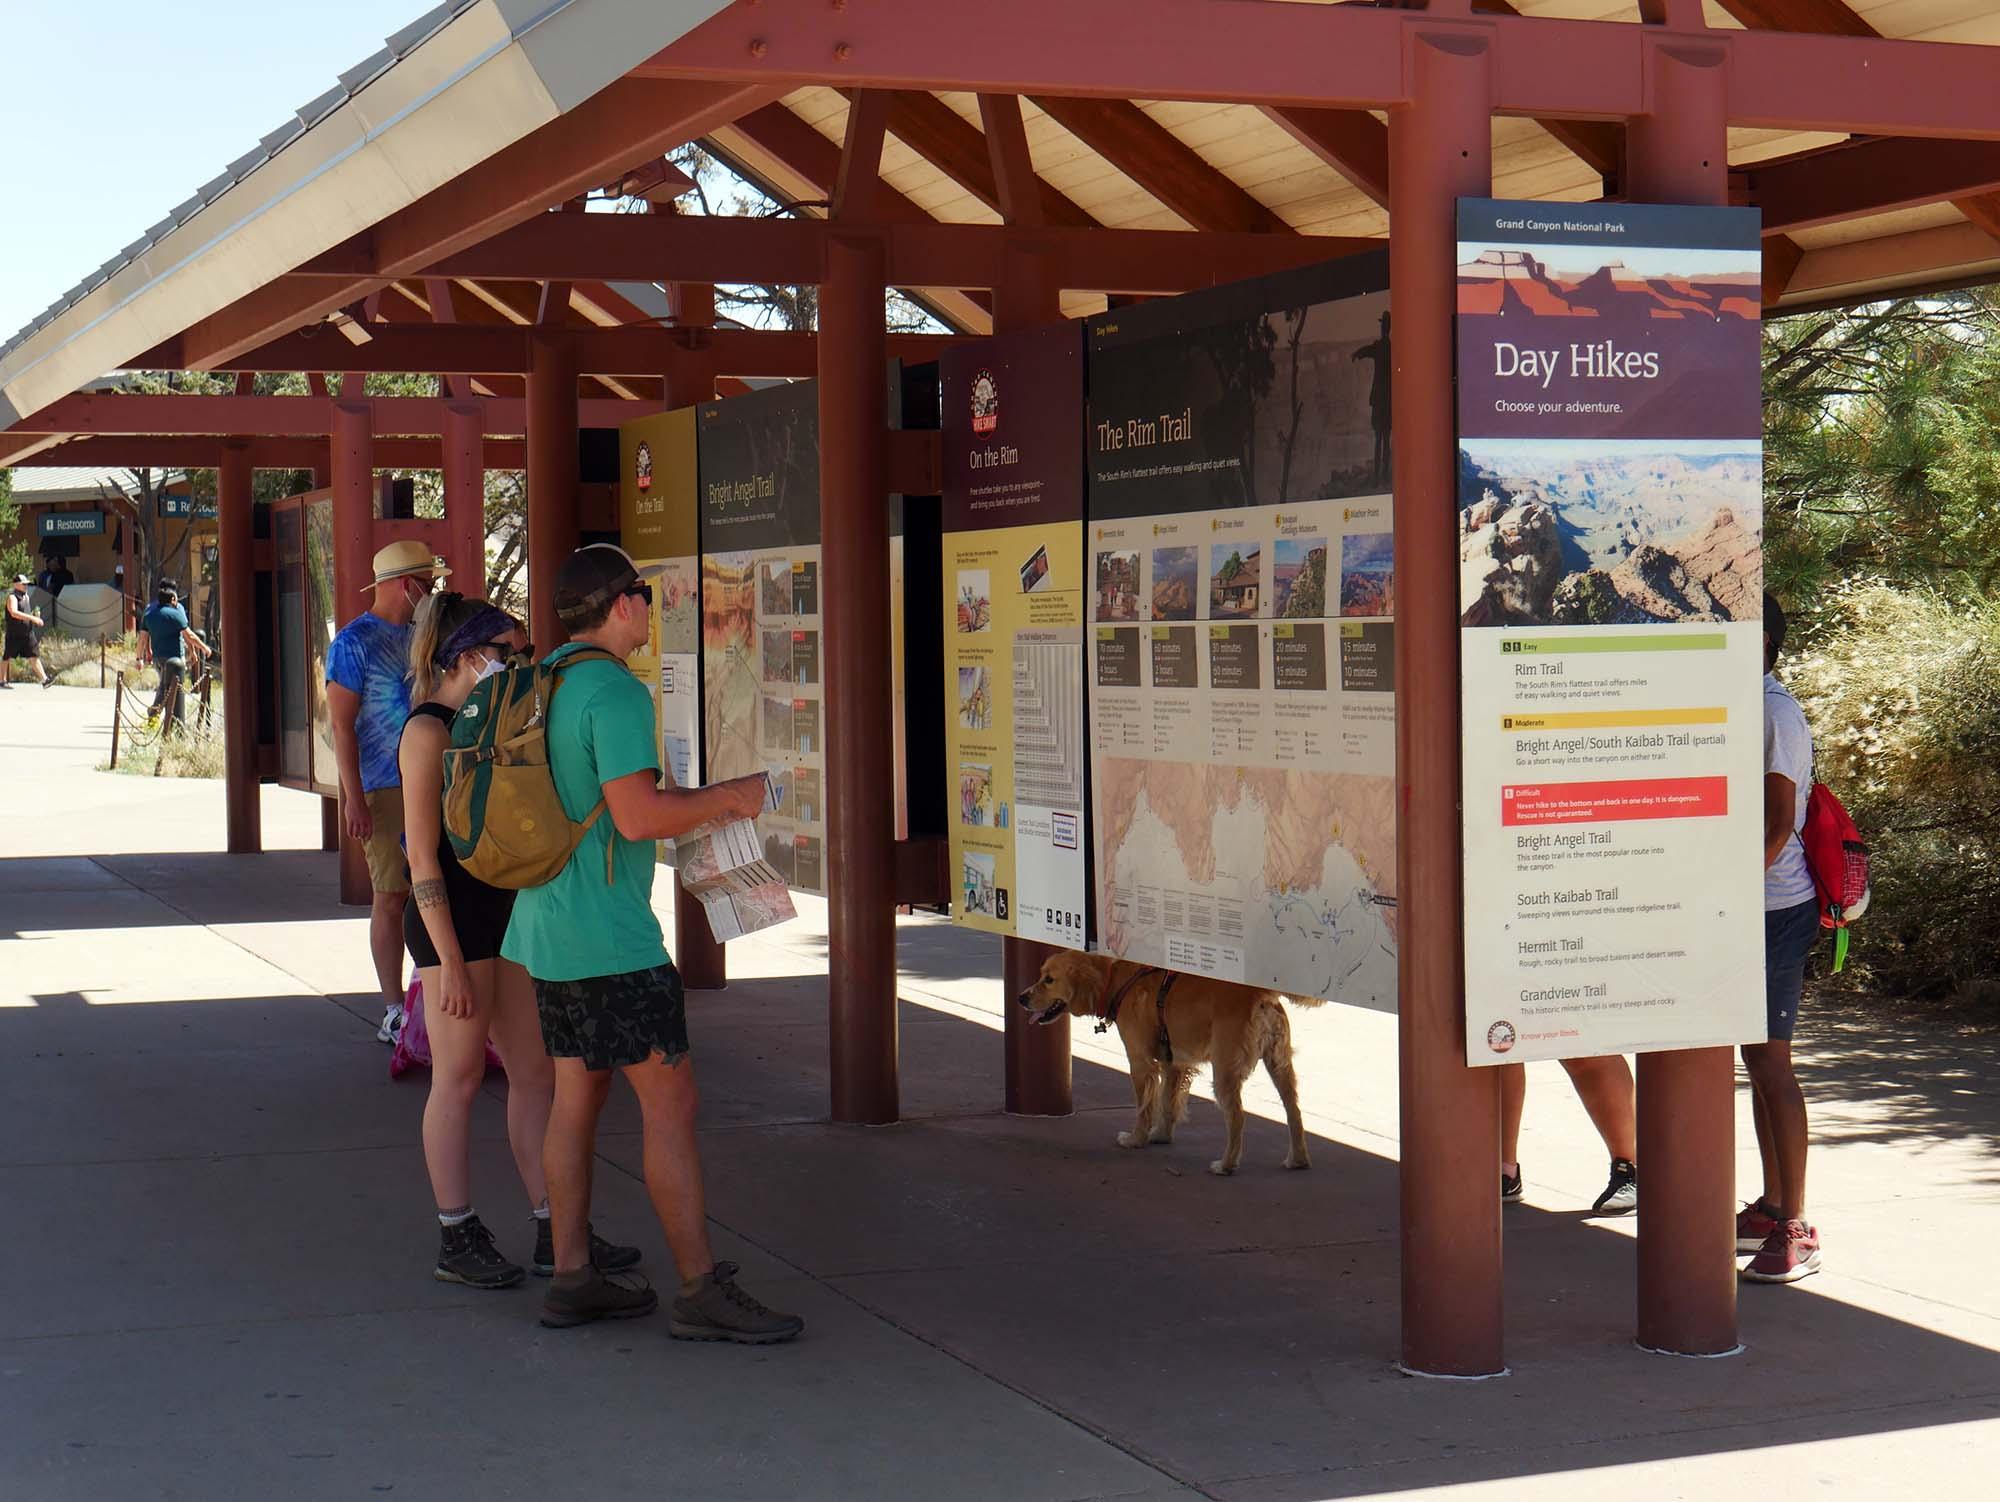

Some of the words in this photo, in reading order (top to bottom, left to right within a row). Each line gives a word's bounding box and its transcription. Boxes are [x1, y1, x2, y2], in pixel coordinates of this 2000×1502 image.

[1495, 218, 1524, 230] Grand
[1526, 220, 1561, 233] Canyon
[1563, 221, 1603, 232] National
[1605, 222, 1625, 233] Park
[1494, 342, 1561, 389] Day
[1569, 339, 1660, 379] Hikes
[1495, 399, 1535, 413] Choose
[1538, 402, 1563, 416] your
[1565, 400, 1624, 414] adventure.
[1097, 419, 1124, 451] The
[1127, 418, 1156, 448] Rim
[1159, 407, 1192, 443] Trail
[970, 450, 983, 470] On
[984, 446, 999, 468] the
[1000, 446, 1018, 465] Rim
[708, 479, 733, 511] Bright
[733, 474, 756, 509] Angel
[756, 471, 775, 499] Trail
[57, 519, 96, 531] Restrooms
[1523, 642, 1538, 652] Easy
[1515, 663, 1537, 676] Rim
[1539, 661, 1563, 675] Trail
[1515, 681, 1528, 690] The
[1529, 680, 1548, 690] South
[1549, 680, 1568, 689] Rim's
[1568, 679, 1593, 689] flattest
[1594, 679, 1608, 687] trail
[1608, 678, 1629, 687] offers
[1630, 677, 1648, 686] miles
[1515, 692, 1523, 700] of
[1524, 692, 1538, 702] easy
[1540, 690, 1567, 701] walking
[1567, 690, 1581, 698] and
[1582, 689, 1600, 699] quiet
[1515, 719, 1545, 728] Moderate
[1516, 738, 1550, 756] Bright
[1553, 735, 1622, 754] Angel/South
[1625, 733, 1664, 748] Kaibab
[1666, 732, 1690, 747] Trail
[1692, 733, 1726, 748] (partial)
[1515, 757, 1527, 766] Go
[1533, 757, 1550, 765] short
[1552, 757, 1566, 767] way
[1567, 756, 1581, 764] into
[1582, 755, 1593, 763] the
[1594, 755, 1618, 765] canyon
[1619, 754, 1629, 762] on
[1630, 752, 1650, 761] either
[1550, 801, 1557, 809] to
[1558, 800, 1569, 808] the
[1569, 799, 1592, 808] bottom
[1593, 798, 1606, 807] and
[1606, 797, 1620, 805] back
[1517, 834, 1551, 851] Bright
[1553, 831, 1586, 849] Angel
[1588, 830, 1612, 845] Trail
[1517, 853, 1530, 861] This
[1532, 853, 1550, 862] steep
[1551, 852, 1565, 860] trail
[1566, 851, 1573, 859] is
[1573, 850, 1585, 858] the
[1585, 850, 1602, 858] most
[1603, 848, 1630, 859] popular
[1630, 847, 1650, 856] route
[1650, 846, 1665, 855] into
[1517, 863, 1529, 872] the
[1517, 891, 1550, 906] South
[1553, 888, 1592, 904] Kaibab
[1595, 887, 1619, 902] Trail
[1517, 910, 1551, 921] Sweeping
[1552, 909, 1571, 918] views
[1571, 907, 1602, 917] surround
[1602, 906, 1615, 915] this
[1616, 905, 1635, 916] steep
[1635, 903, 1666, 914] ridgeline
[1518, 940, 1558, 954] Hermit
[1560, 936, 1584, 951] Trail
[1518, 959, 1544, 969] Rough,
[1544, 958, 1563, 968] rocky
[1564, 957, 1579, 965] trail
[1579, 956, 1587, 964] to
[1588, 954, 1608, 963] broad
[1631, 952, 1644, 960] and
[1646, 951, 1666, 960] desert
[1520, 986, 1581, 1002] Grandview
[1583, 983, 1607, 998] Trail
[1520, 1007, 1534, 1016] This
[1535, 1005, 1560, 1015] historic
[1561, 1003, 1585, 1013] miner's
[1586, 1002, 1601, 1011] trail
[1608, 1001, 1623, 1011] very
[1624, 999, 1642, 1010] steep
[1643, 998, 1656, 1007] and
[1520, 1032, 1542, 1041] Know
[1542, 1031, 1559, 1041] your
